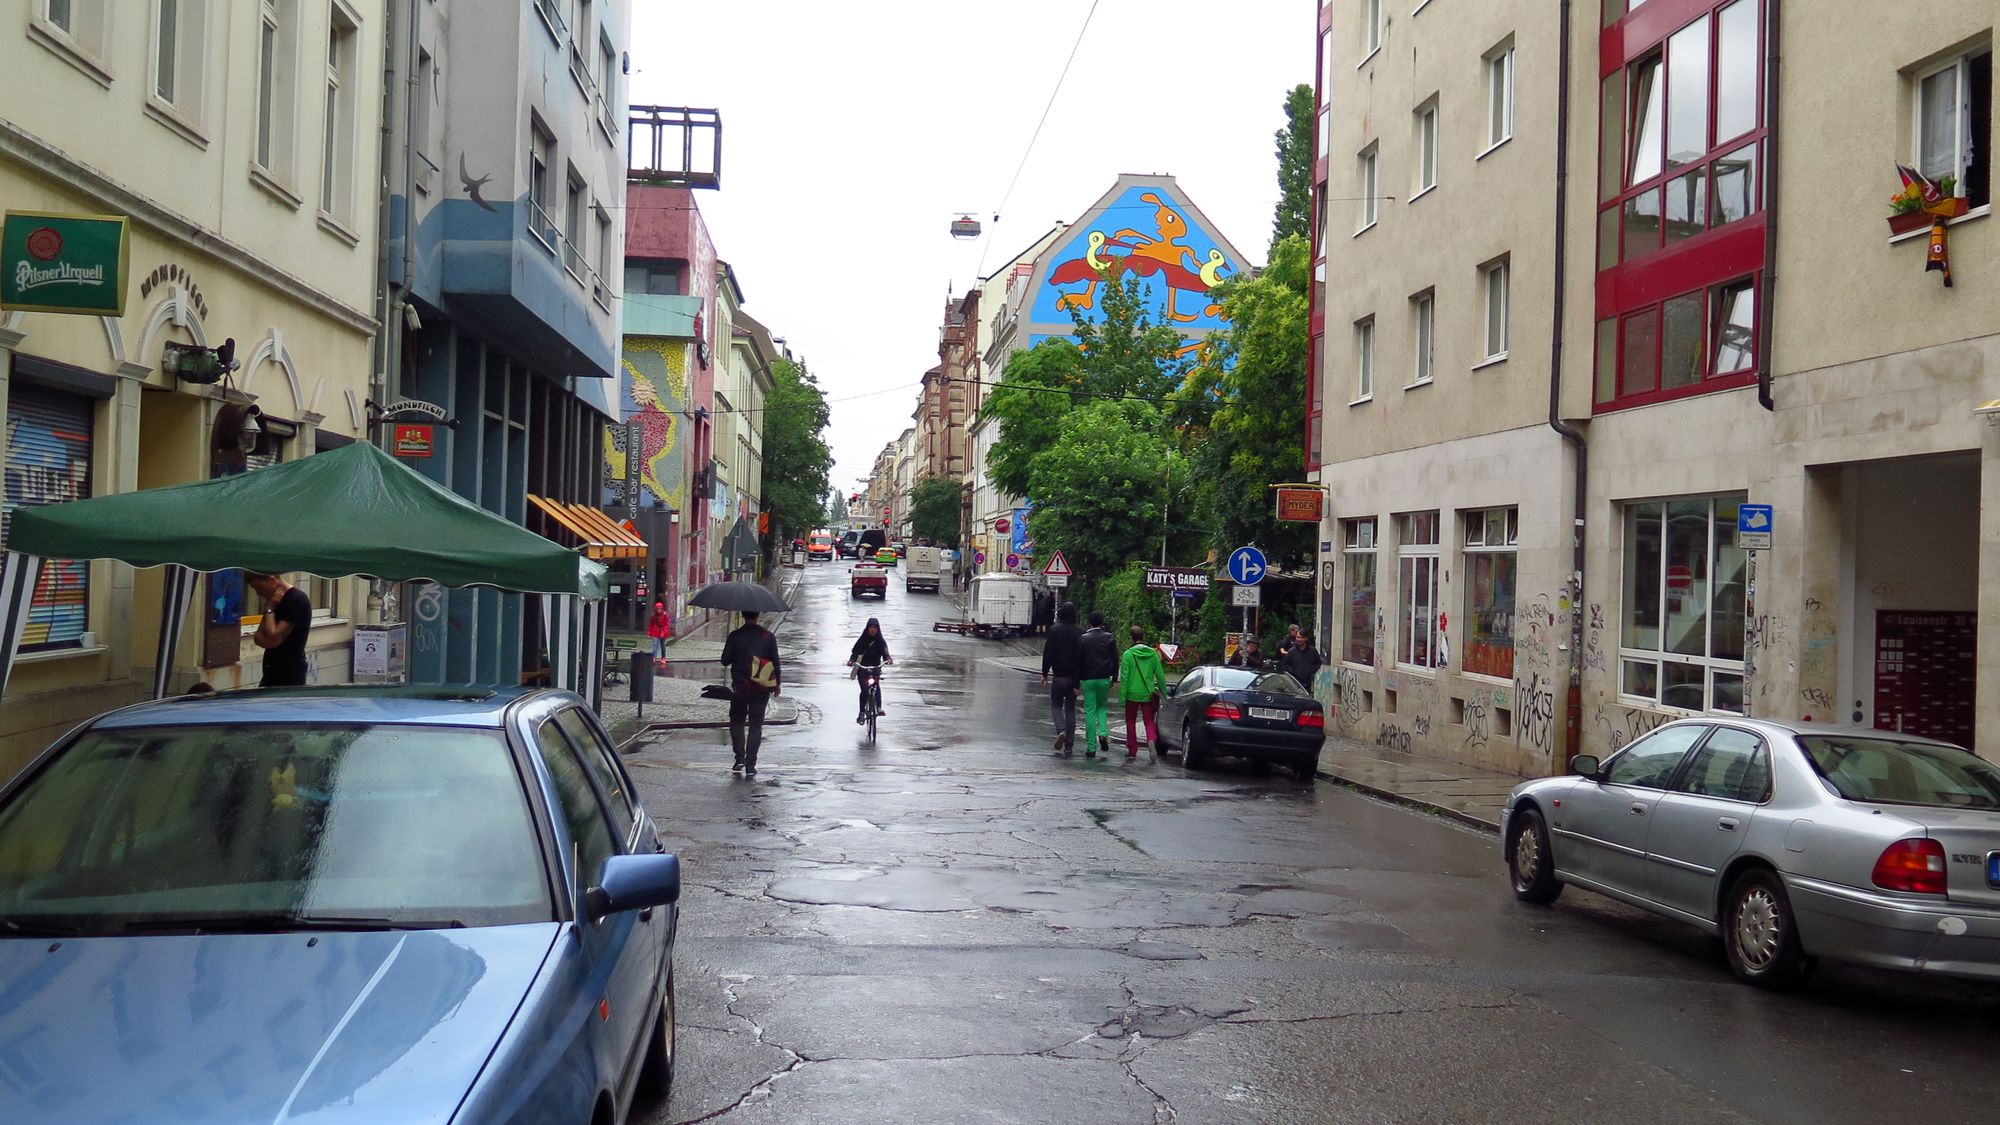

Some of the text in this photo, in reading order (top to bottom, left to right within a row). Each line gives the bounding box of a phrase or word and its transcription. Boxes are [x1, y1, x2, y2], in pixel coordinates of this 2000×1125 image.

[16, 260, 103, 292] Pilsner Urquell
[387, 402, 442, 416] MONDFISCH
[631, 426, 640, 475] restaurant
[630, 478, 638, 495] bar
[1147, 572, 1209, 585] KATY'S GARAGE
